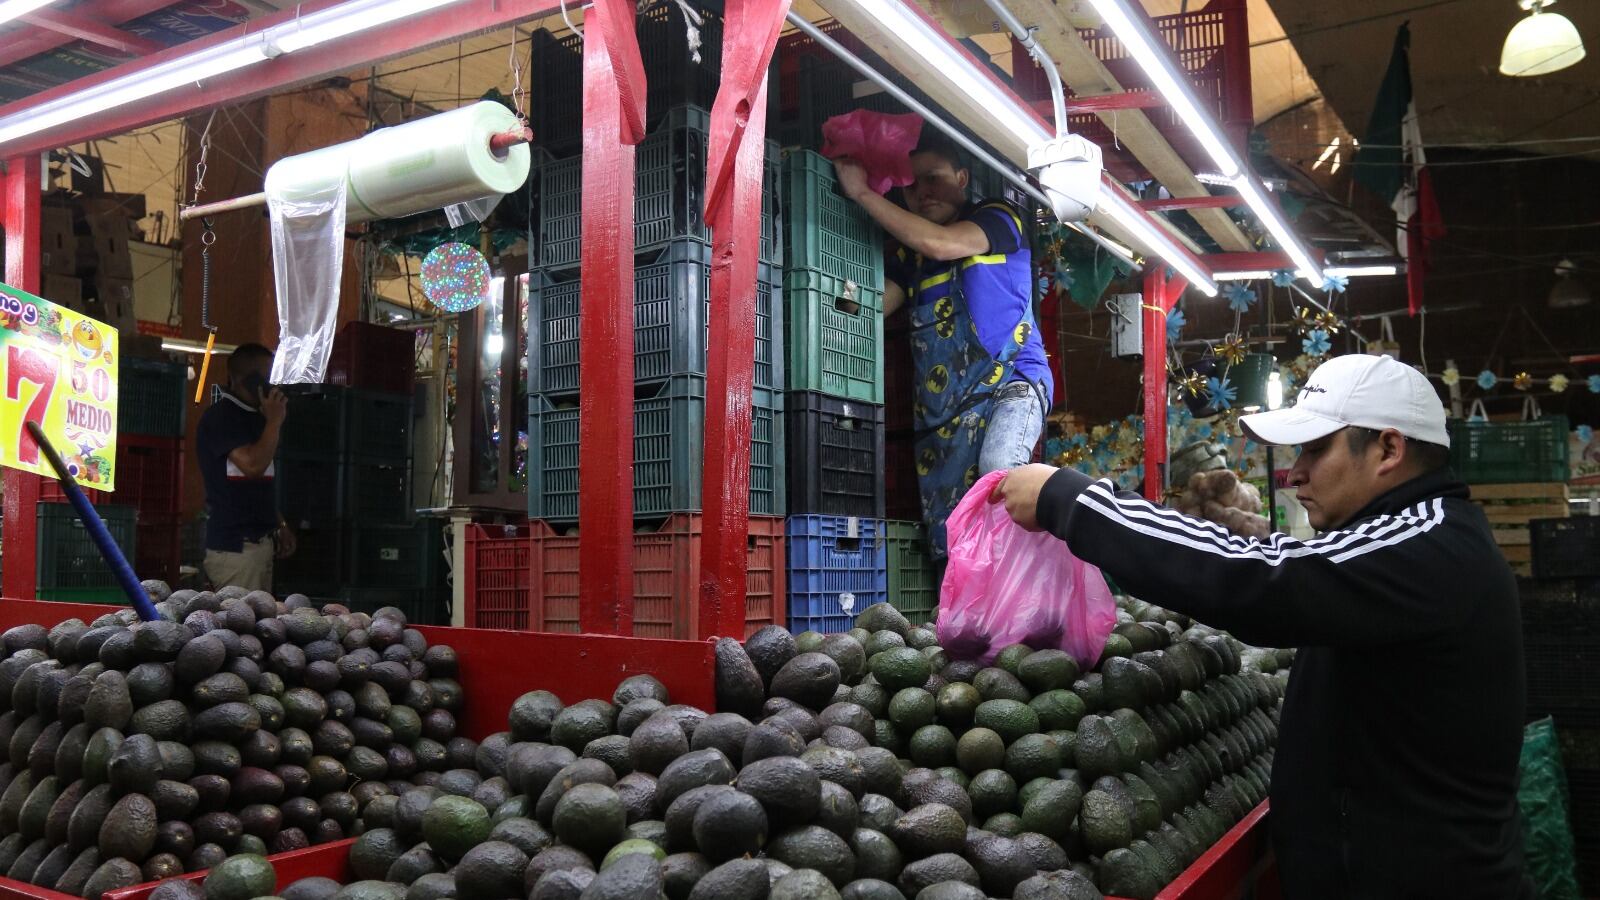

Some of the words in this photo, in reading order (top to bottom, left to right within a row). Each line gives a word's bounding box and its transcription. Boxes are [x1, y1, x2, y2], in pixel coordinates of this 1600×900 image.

[0, 293, 20, 313] no
[72, 360, 108, 401] 50
[7, 345, 57, 465] 7
[66, 400, 112, 435] MEDIO
